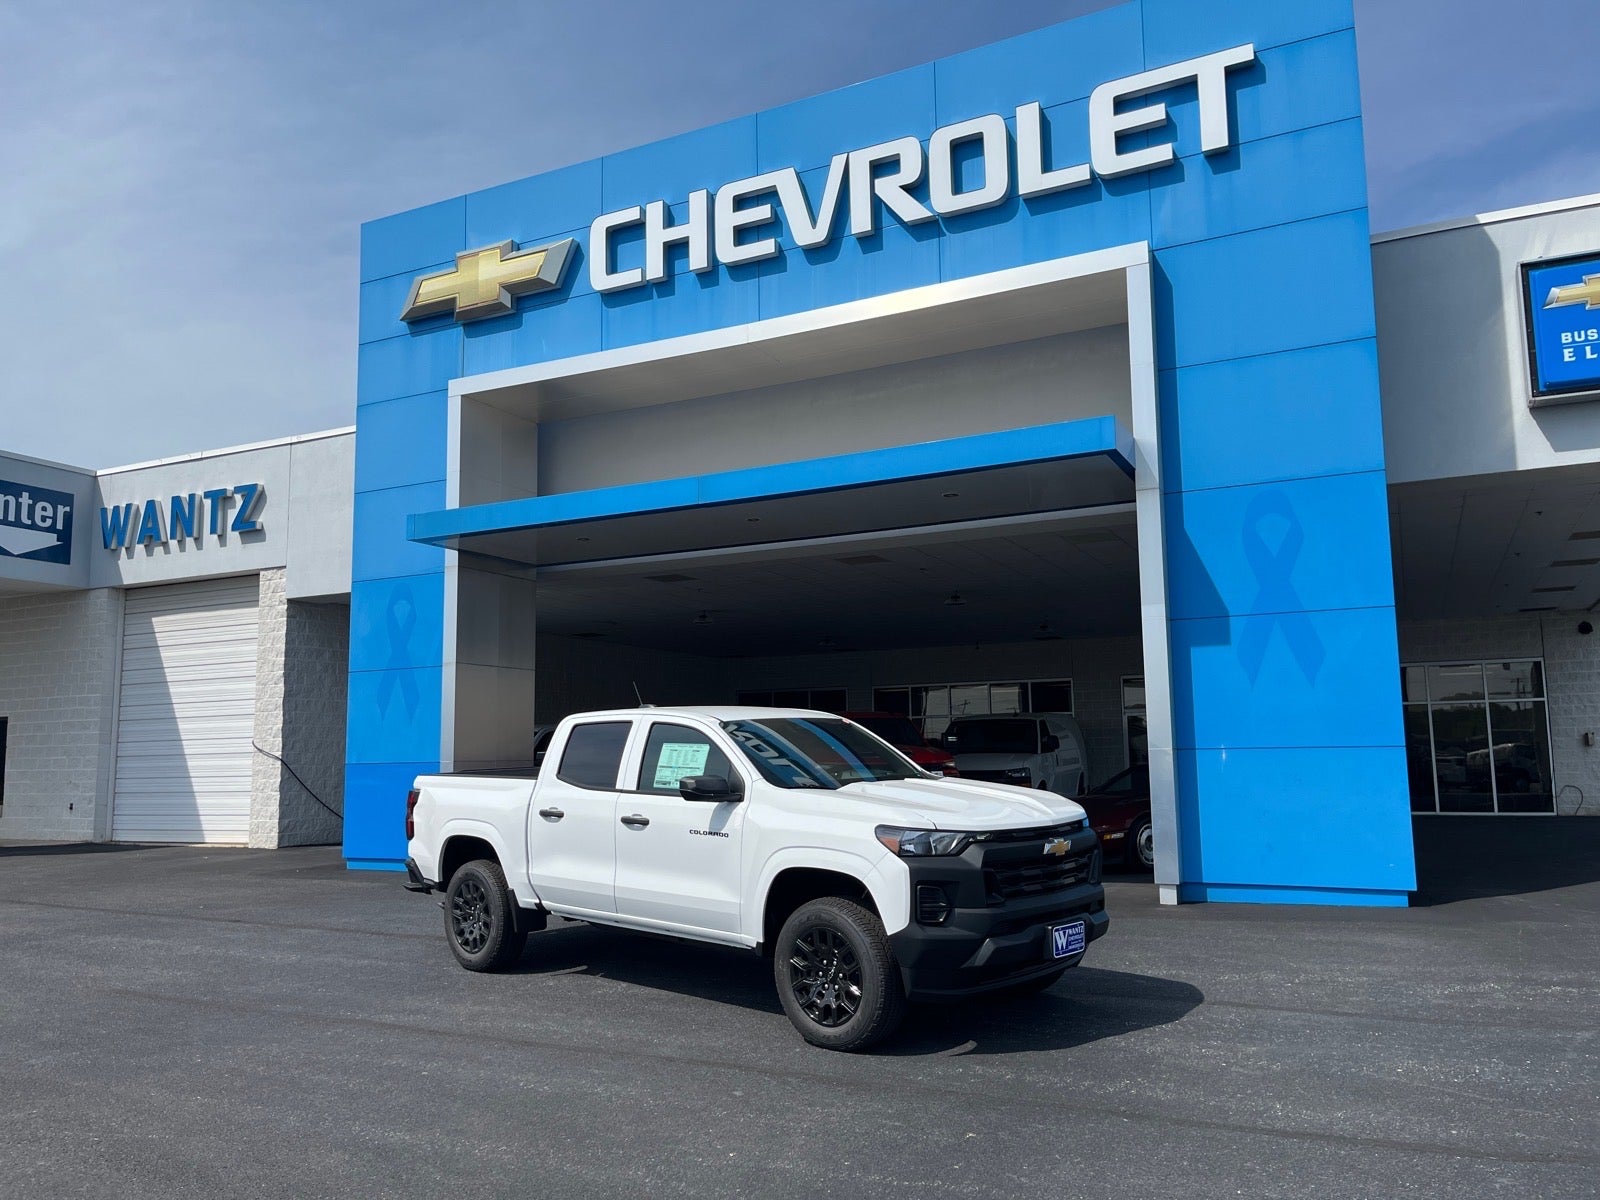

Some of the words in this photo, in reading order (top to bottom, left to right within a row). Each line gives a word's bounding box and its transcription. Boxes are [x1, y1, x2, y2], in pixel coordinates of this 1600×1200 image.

[589, 43, 1255, 293] CHEVROLET
[1561, 329, 1598, 344] BUS
[0, 487, 70, 530] nter
[100, 483, 264, 550] WANTZ
[689, 829, 729, 838] COLORADO
